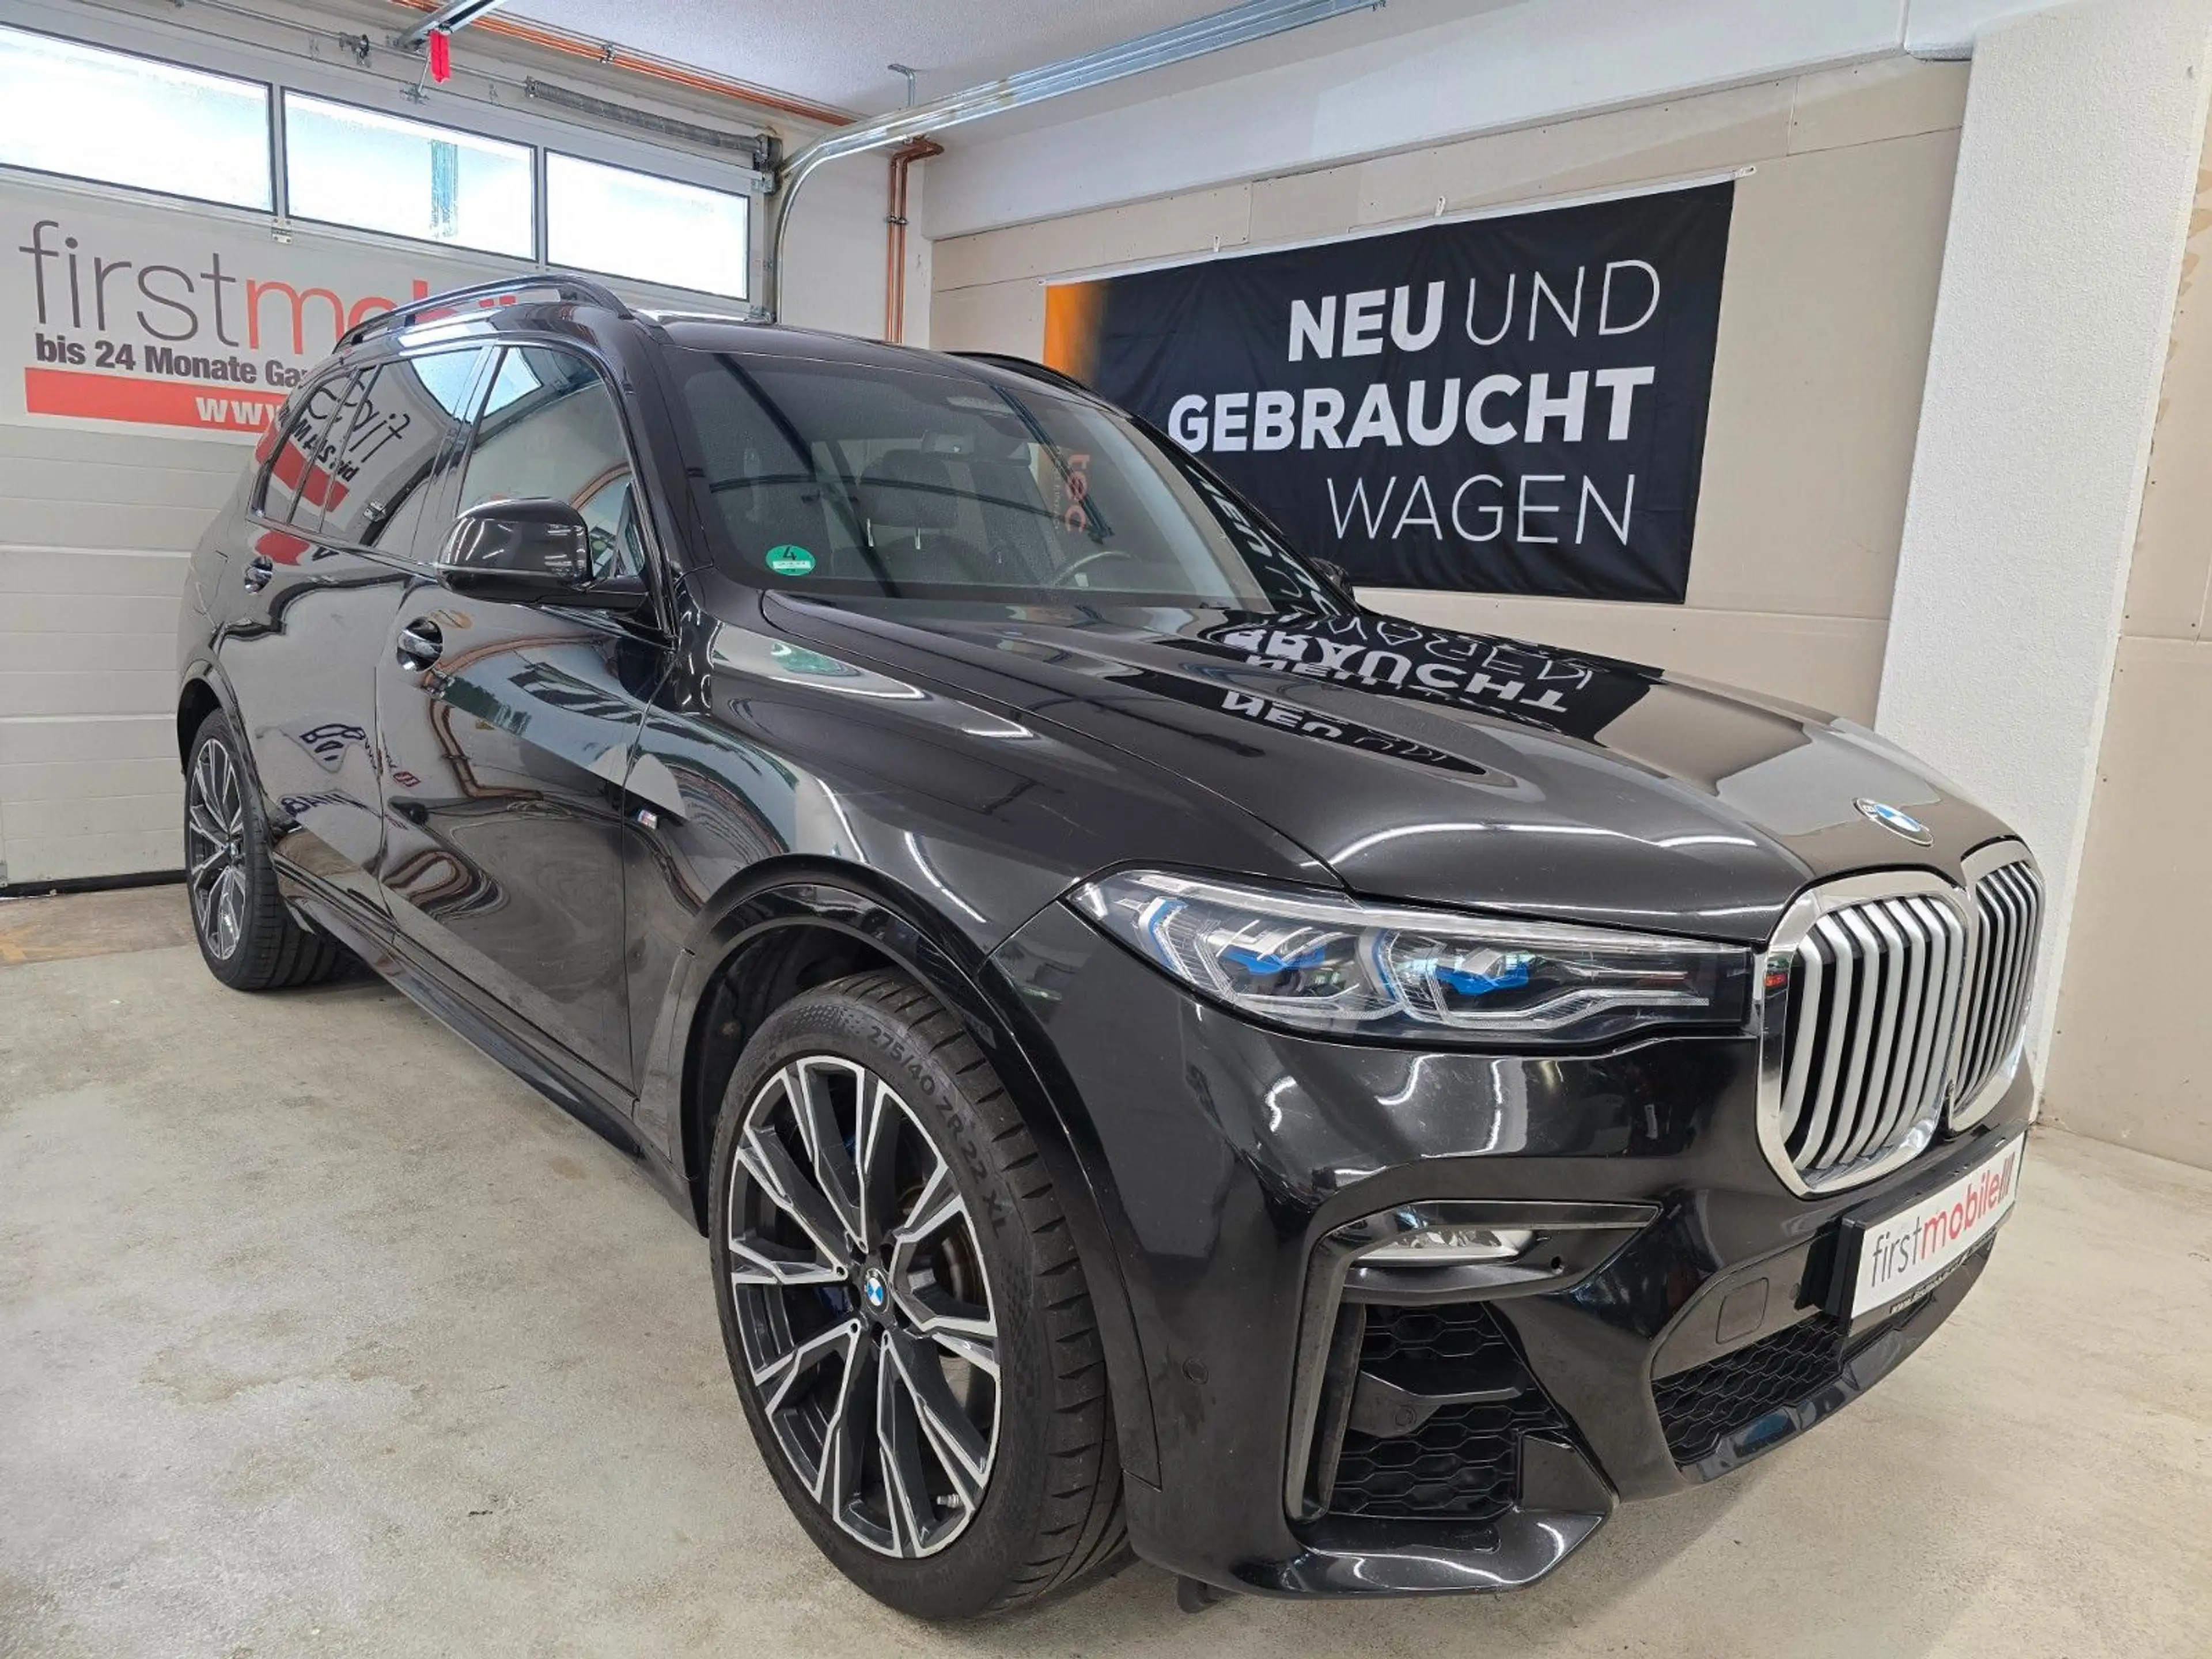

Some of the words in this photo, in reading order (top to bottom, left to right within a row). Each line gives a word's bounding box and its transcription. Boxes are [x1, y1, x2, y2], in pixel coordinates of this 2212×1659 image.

[1288, 280, 1445, 362] NEU
[1465, 259, 1660, 346] UND
[35, 332, 86, 365] bis
[94, 339, 136, 371] 24
[144, 345, 257, 385] Monate
[265, 359, 308, 388] Ga
[1168, 366, 1656, 454] GEBRAUCHT
[1326, 474, 1635, 546] WAGEN
[868, 1025, 935, 1096] 275/40
